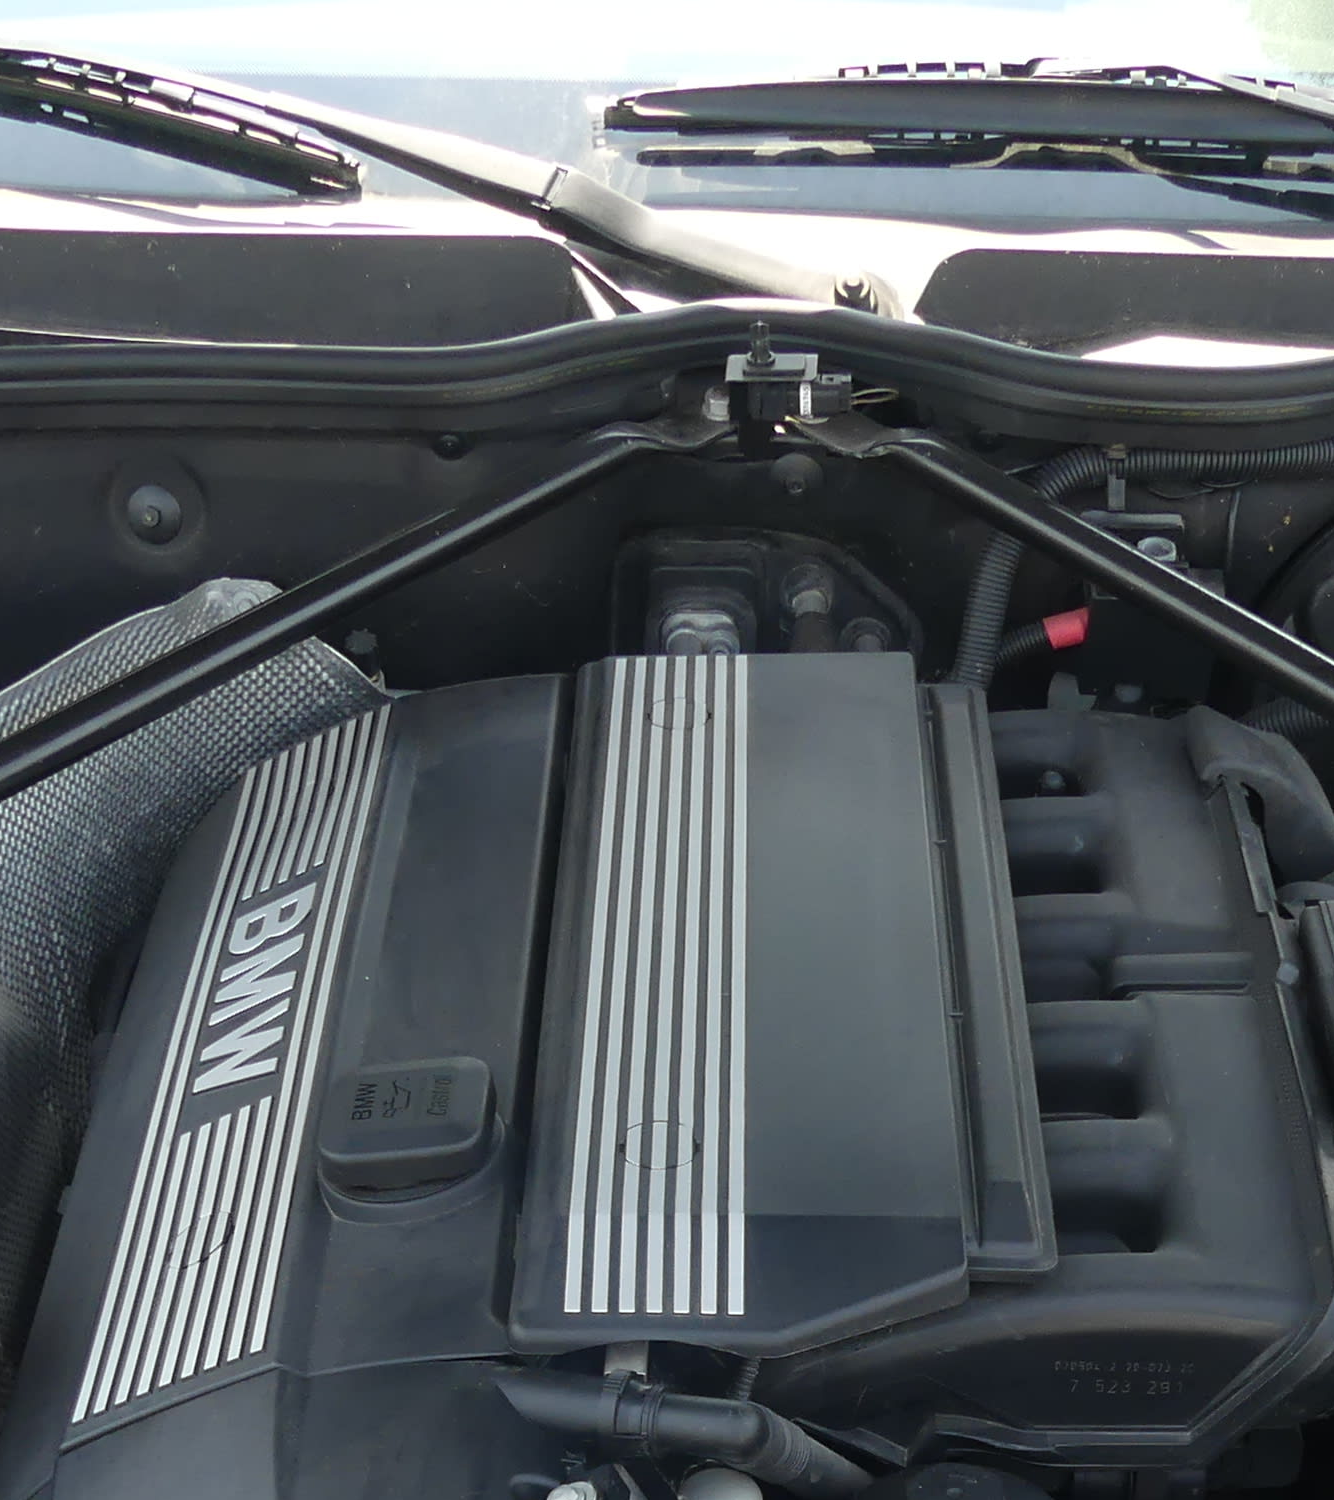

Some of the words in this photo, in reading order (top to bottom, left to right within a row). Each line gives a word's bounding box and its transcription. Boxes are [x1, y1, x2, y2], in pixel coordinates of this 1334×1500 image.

[192, 881, 316, 1094] BMW
[351, 1083, 378, 1120] BMW
[1095, 1379, 1132, 1394] 523
